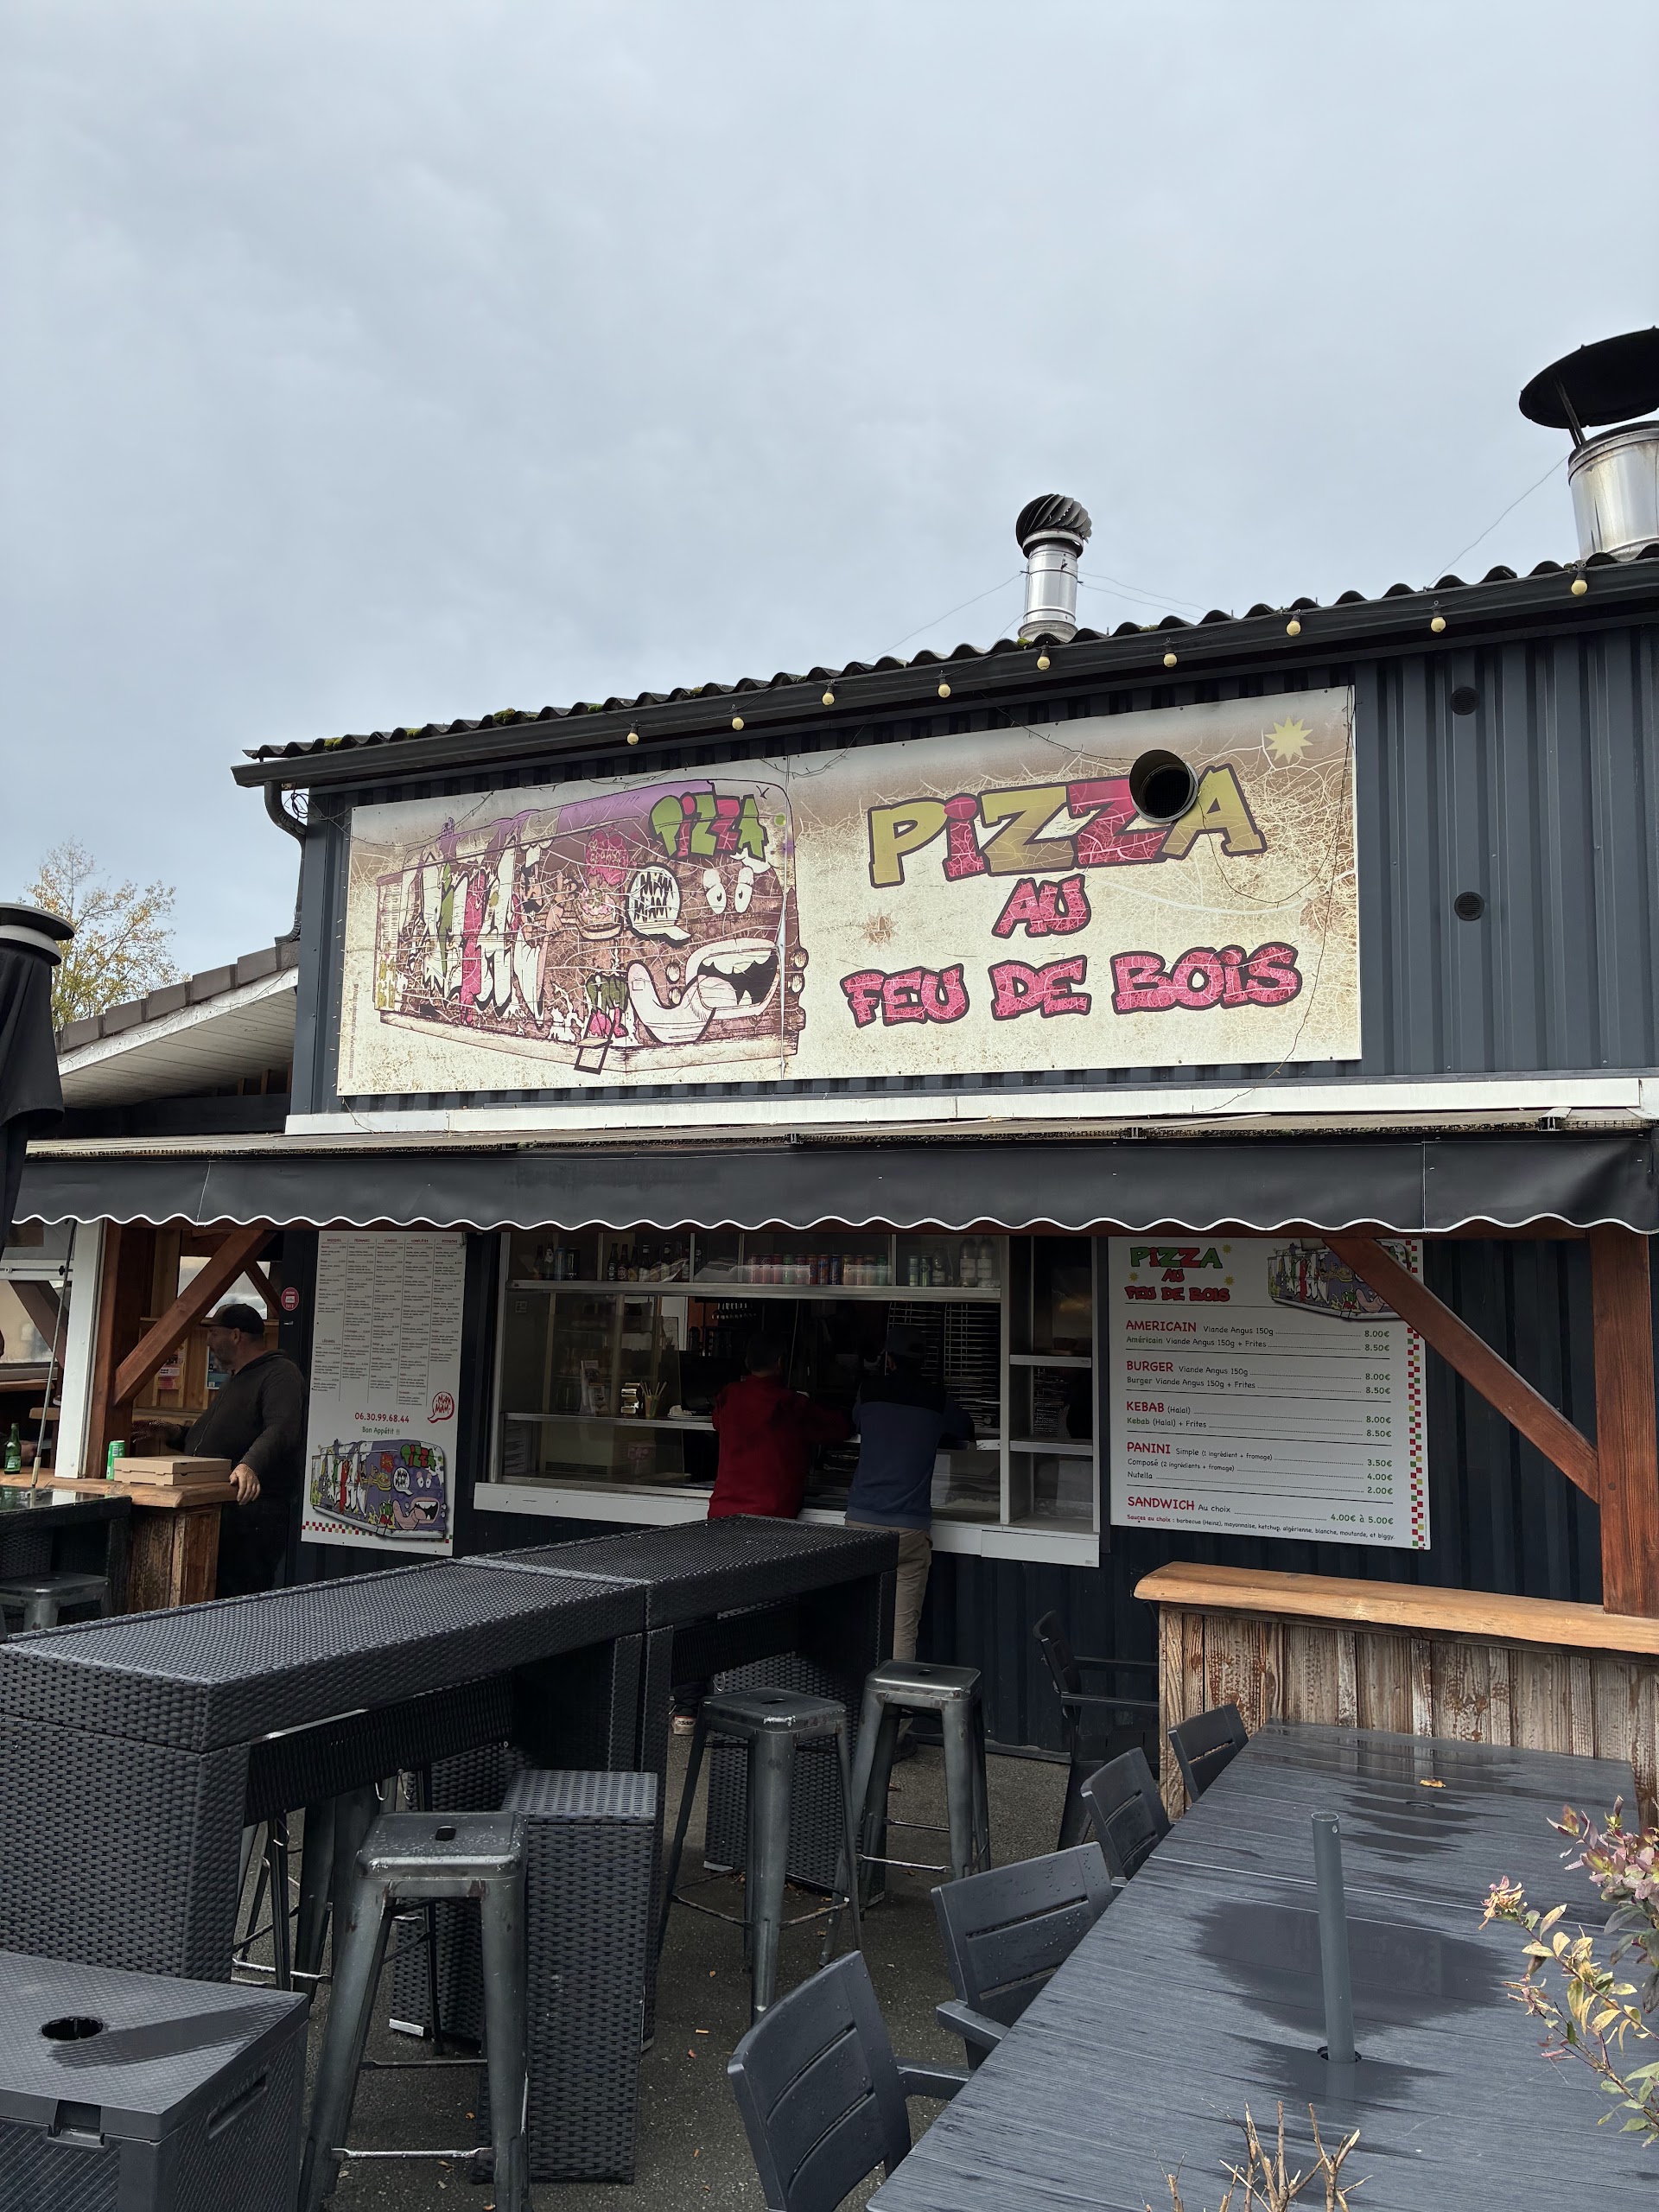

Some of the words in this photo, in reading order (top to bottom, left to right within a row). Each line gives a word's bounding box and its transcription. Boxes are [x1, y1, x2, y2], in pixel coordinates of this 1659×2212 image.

[991, 875, 1091, 938] AU
[840, 963, 970, 1027] FEU
[988, 955, 1091, 1020] DE
[1161, 1268, 1185, 1282] AU
[1124, 1286, 1156, 1300] FEU
[1161, 1287, 1185, 1300] DE
[1126, 1320, 1197, 1332] AMERICAIN
[1192, 1338, 1215, 1347] Angus
[1217, 1339, 1235, 1348] 150g
[1127, 1361, 1173, 1372] BURGER
[1205, 1367, 1228, 1376] Angus
[1230, 1368, 1248, 1376] 150g
[1127, 1376, 1153, 1385] Burger
[1182, 1379, 1205, 1388] Angus
[1207, 1380, 1224, 1389] 150g
[1127, 1402, 1164, 1413] KEBAB
[1167, 1406, 1191, 1414] (Halal)
[355, 1412, 410, 1423] 06.30.99.68.44
[1153, 1418, 1176, 1427] (Halal)
[1127, 1442, 1171, 1454] PANINI
[1176, 1448, 1198, 1457] Simple
[1208, 1451, 1237, 1459] ingrédient
[1246, 1452, 1273, 1461] fromage)
[1128, 1459, 1158, 1467] Composé
[1169, 1461, 1200, 1470] ingrédients
[1209, 1463, 1235, 1472] fromage)
[1367, 1486, 1393, 1495] 2.00€
[1128, 1496, 1195, 1510] SANDWICH
[1368, 1516, 1393, 1525] 5.00€
